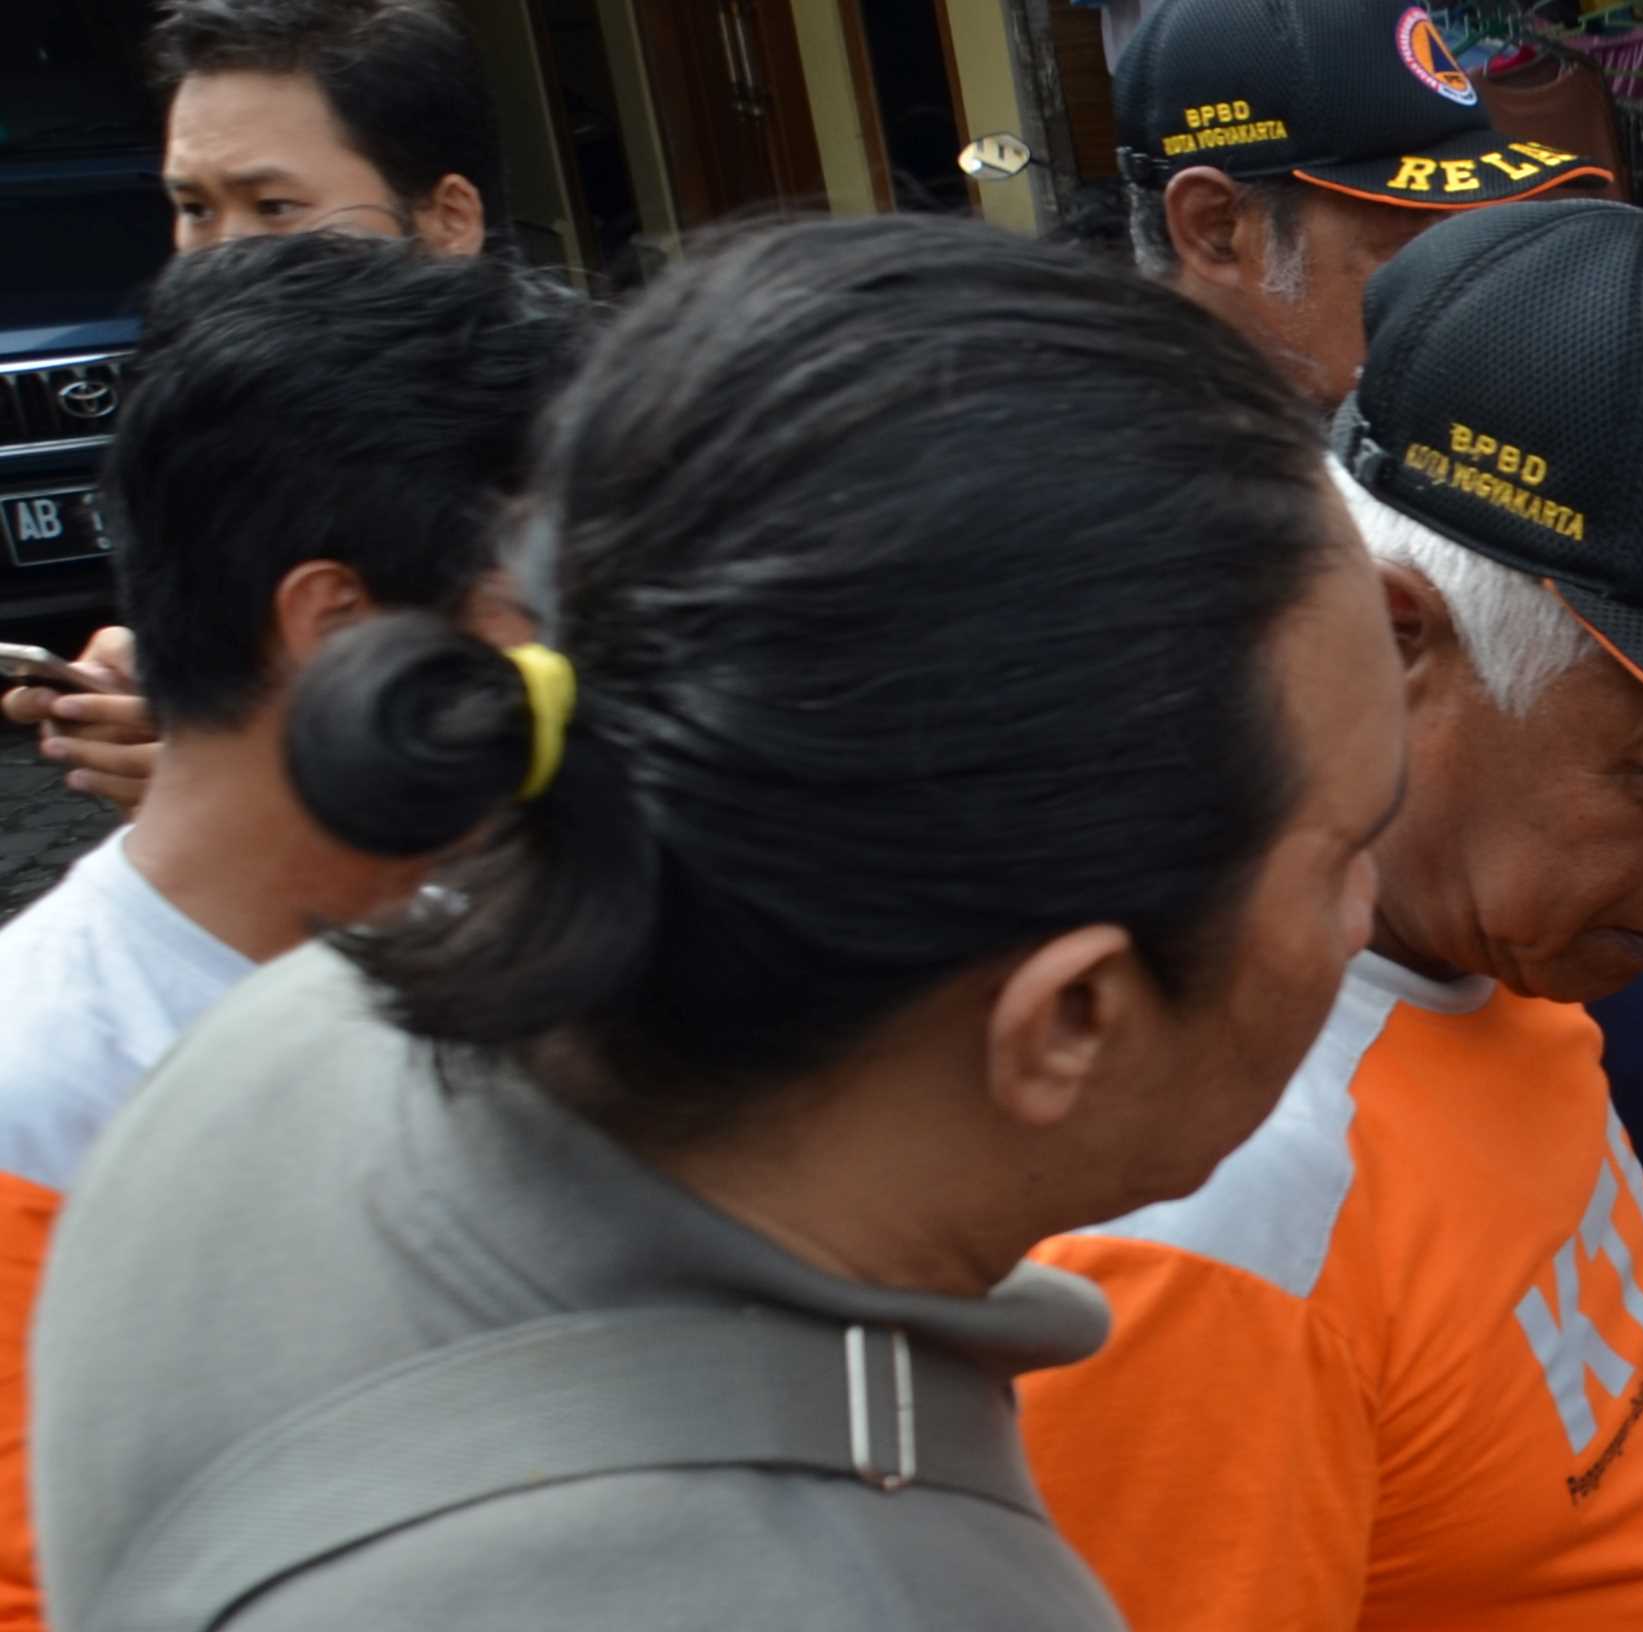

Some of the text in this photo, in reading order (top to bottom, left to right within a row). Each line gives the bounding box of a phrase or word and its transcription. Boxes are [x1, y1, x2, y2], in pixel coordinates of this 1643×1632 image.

[1184, 100, 1250, 128] BPBD
[1450, 422, 1547, 486] BPBD
[17, 498, 62, 541] AB
[1450, 461, 1585, 541] YOGYAKARTA
